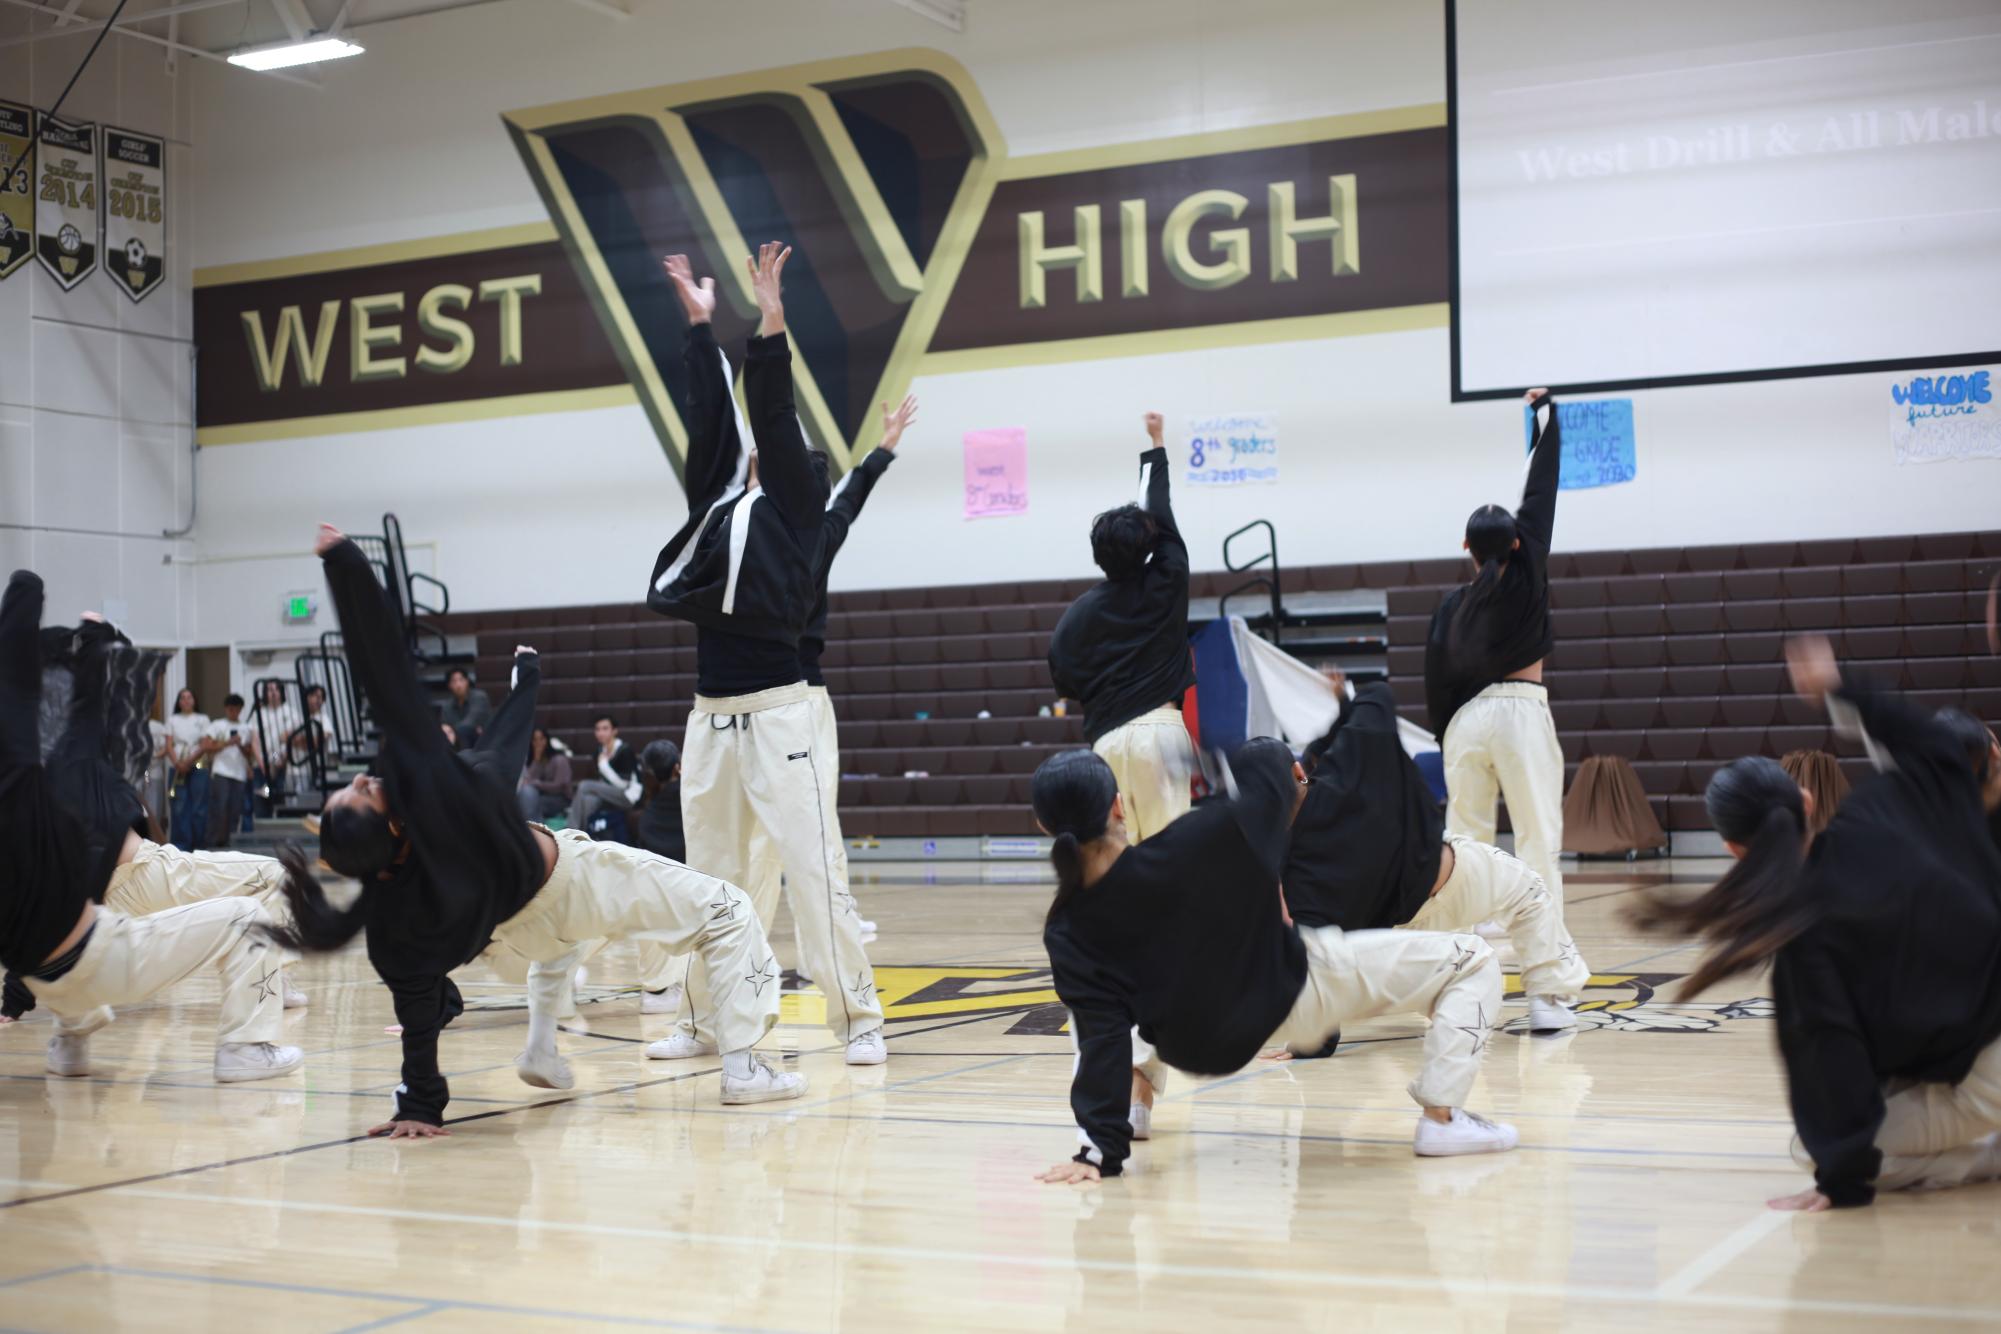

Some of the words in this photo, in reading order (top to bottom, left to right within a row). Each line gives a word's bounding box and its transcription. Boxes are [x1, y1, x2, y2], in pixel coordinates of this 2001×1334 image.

[1518, 143, 1632, 183] West
[1648, 124, 1751, 169] Drill
[1766, 121, 1802, 157] &
[1816, 110, 1883, 152] All
[40, 173, 96, 210] 2014
[108, 188, 163, 224] 2015
[1018, 173, 1360, 308] HIGH
[241, 274, 541, 391] WEST
[1891, 369, 1992, 405] WELCOME
[1559, 401, 1609, 432] COME
[1906, 404, 1978, 428] future
